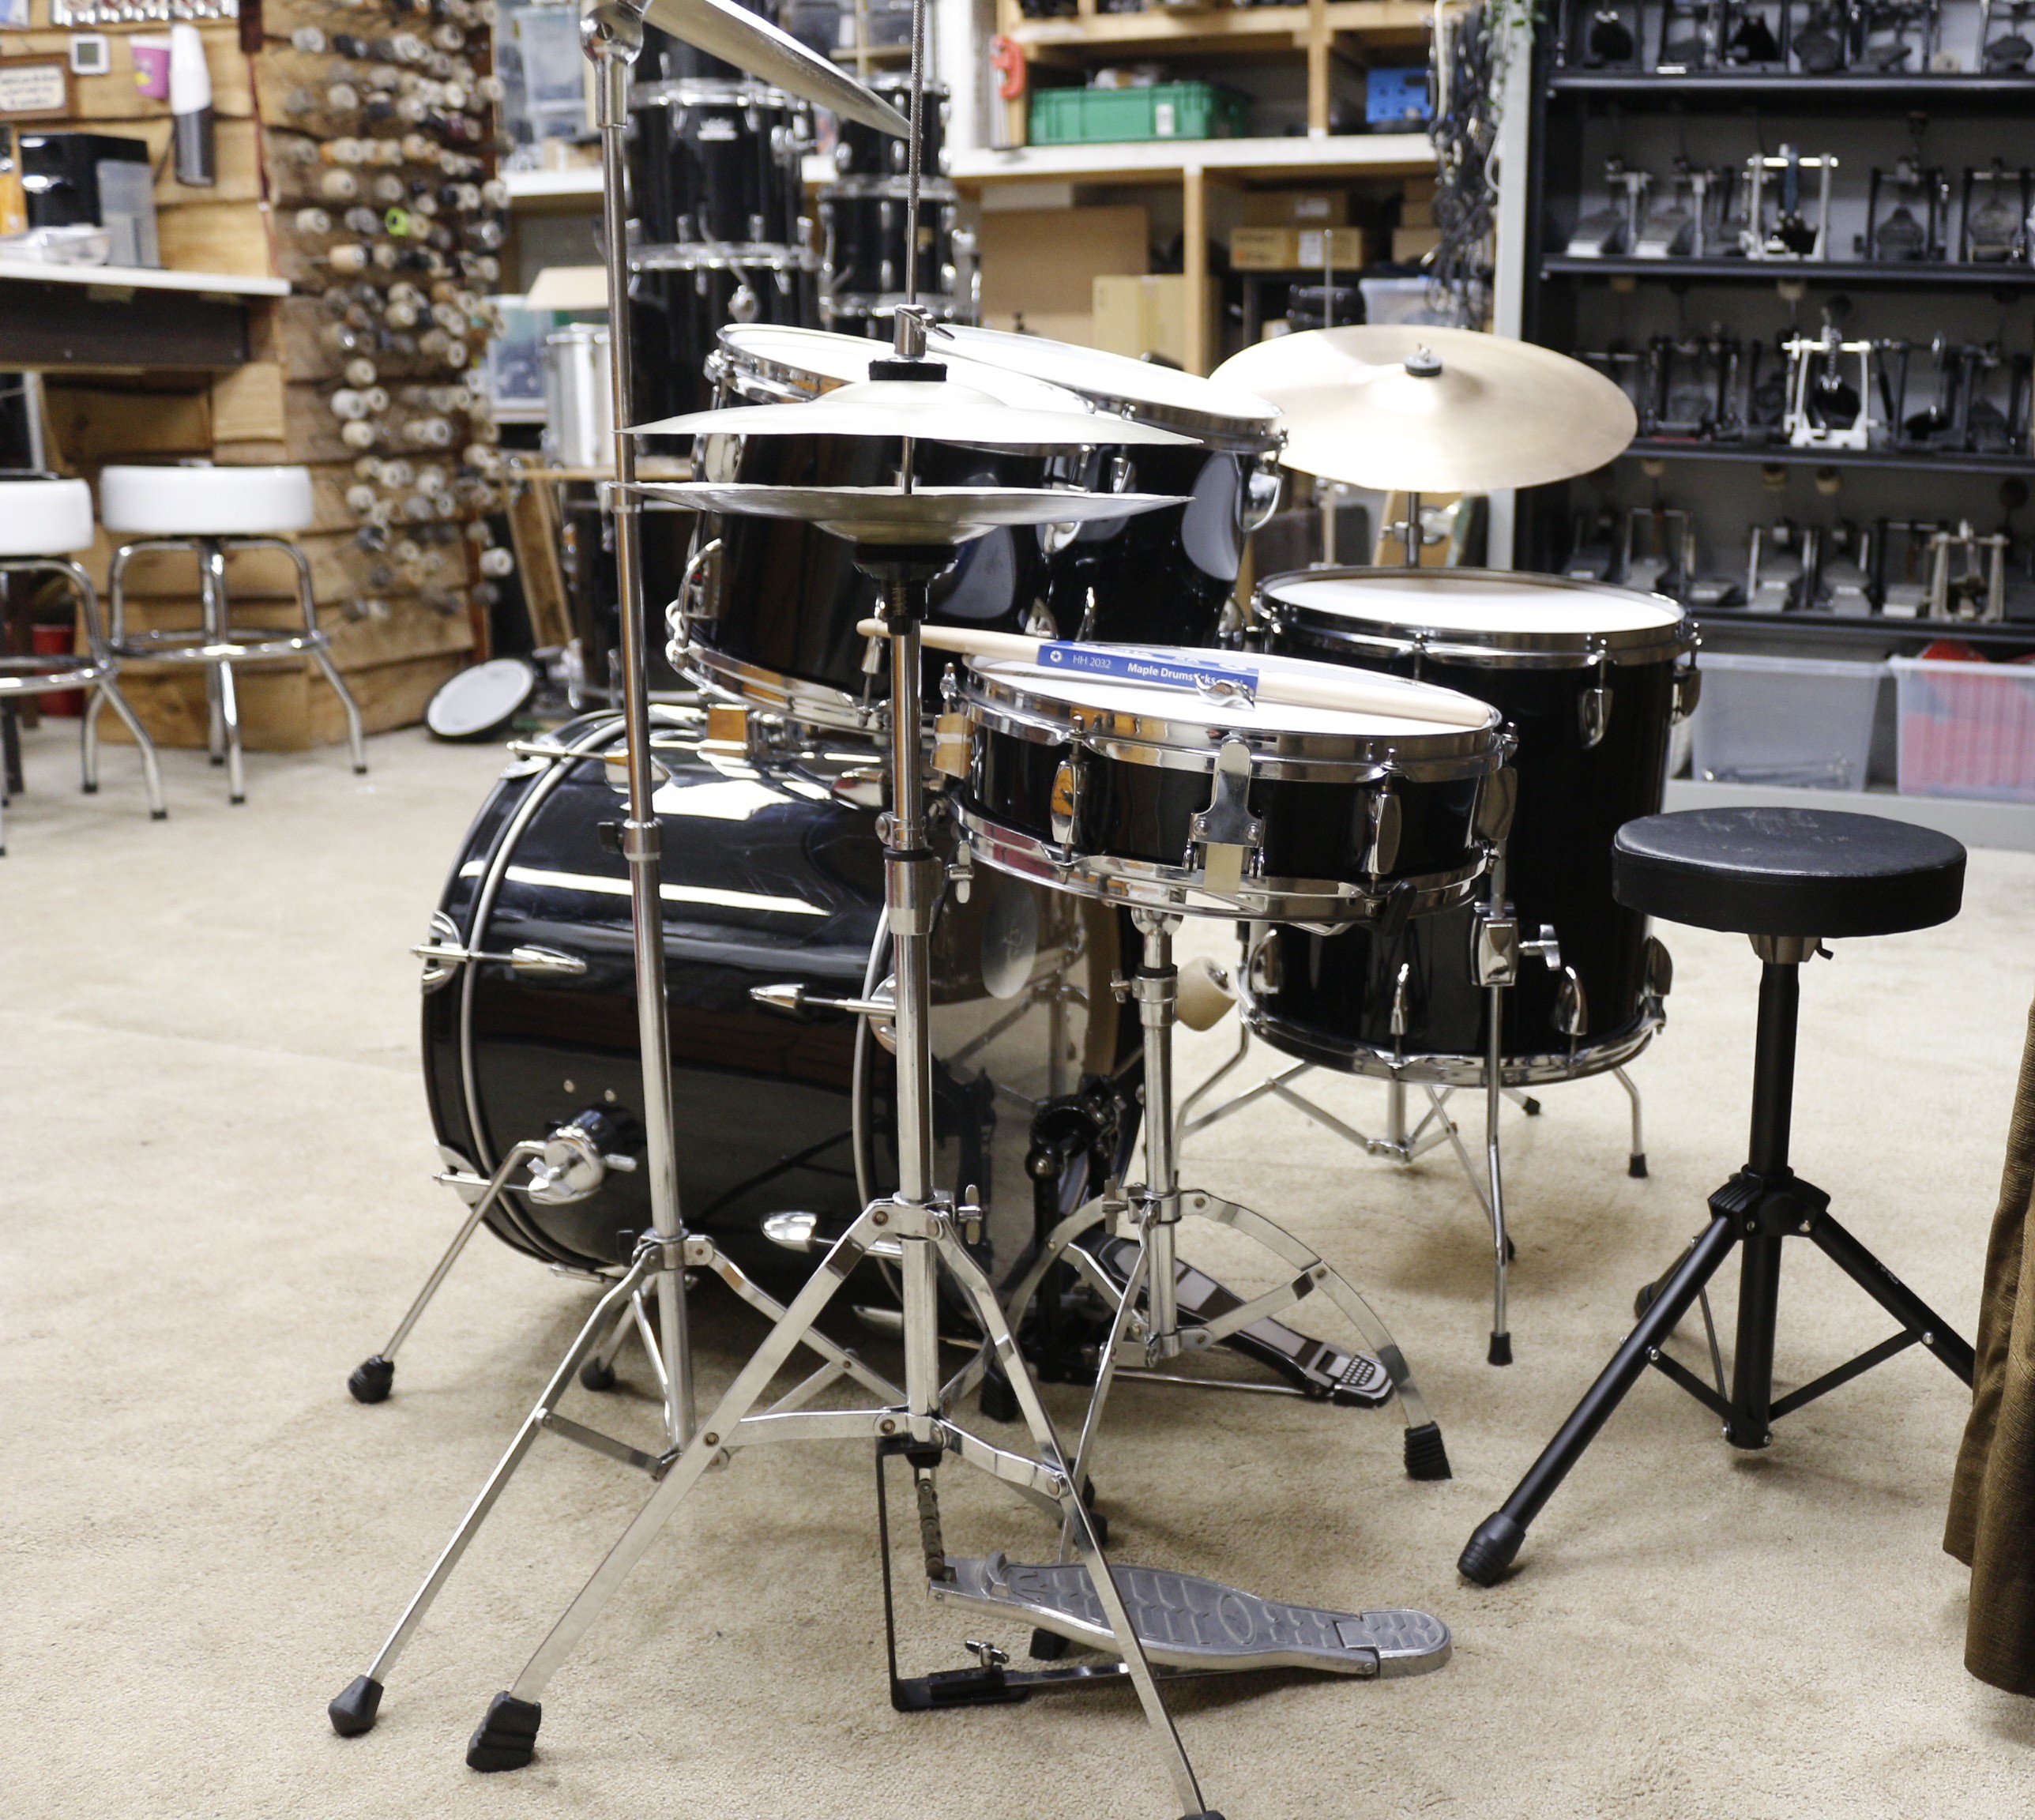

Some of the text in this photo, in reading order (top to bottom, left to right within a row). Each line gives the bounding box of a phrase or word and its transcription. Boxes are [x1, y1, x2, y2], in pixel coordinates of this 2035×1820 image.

[1073, 655, 1216, 685] HH 2032 Maple Drumsks
